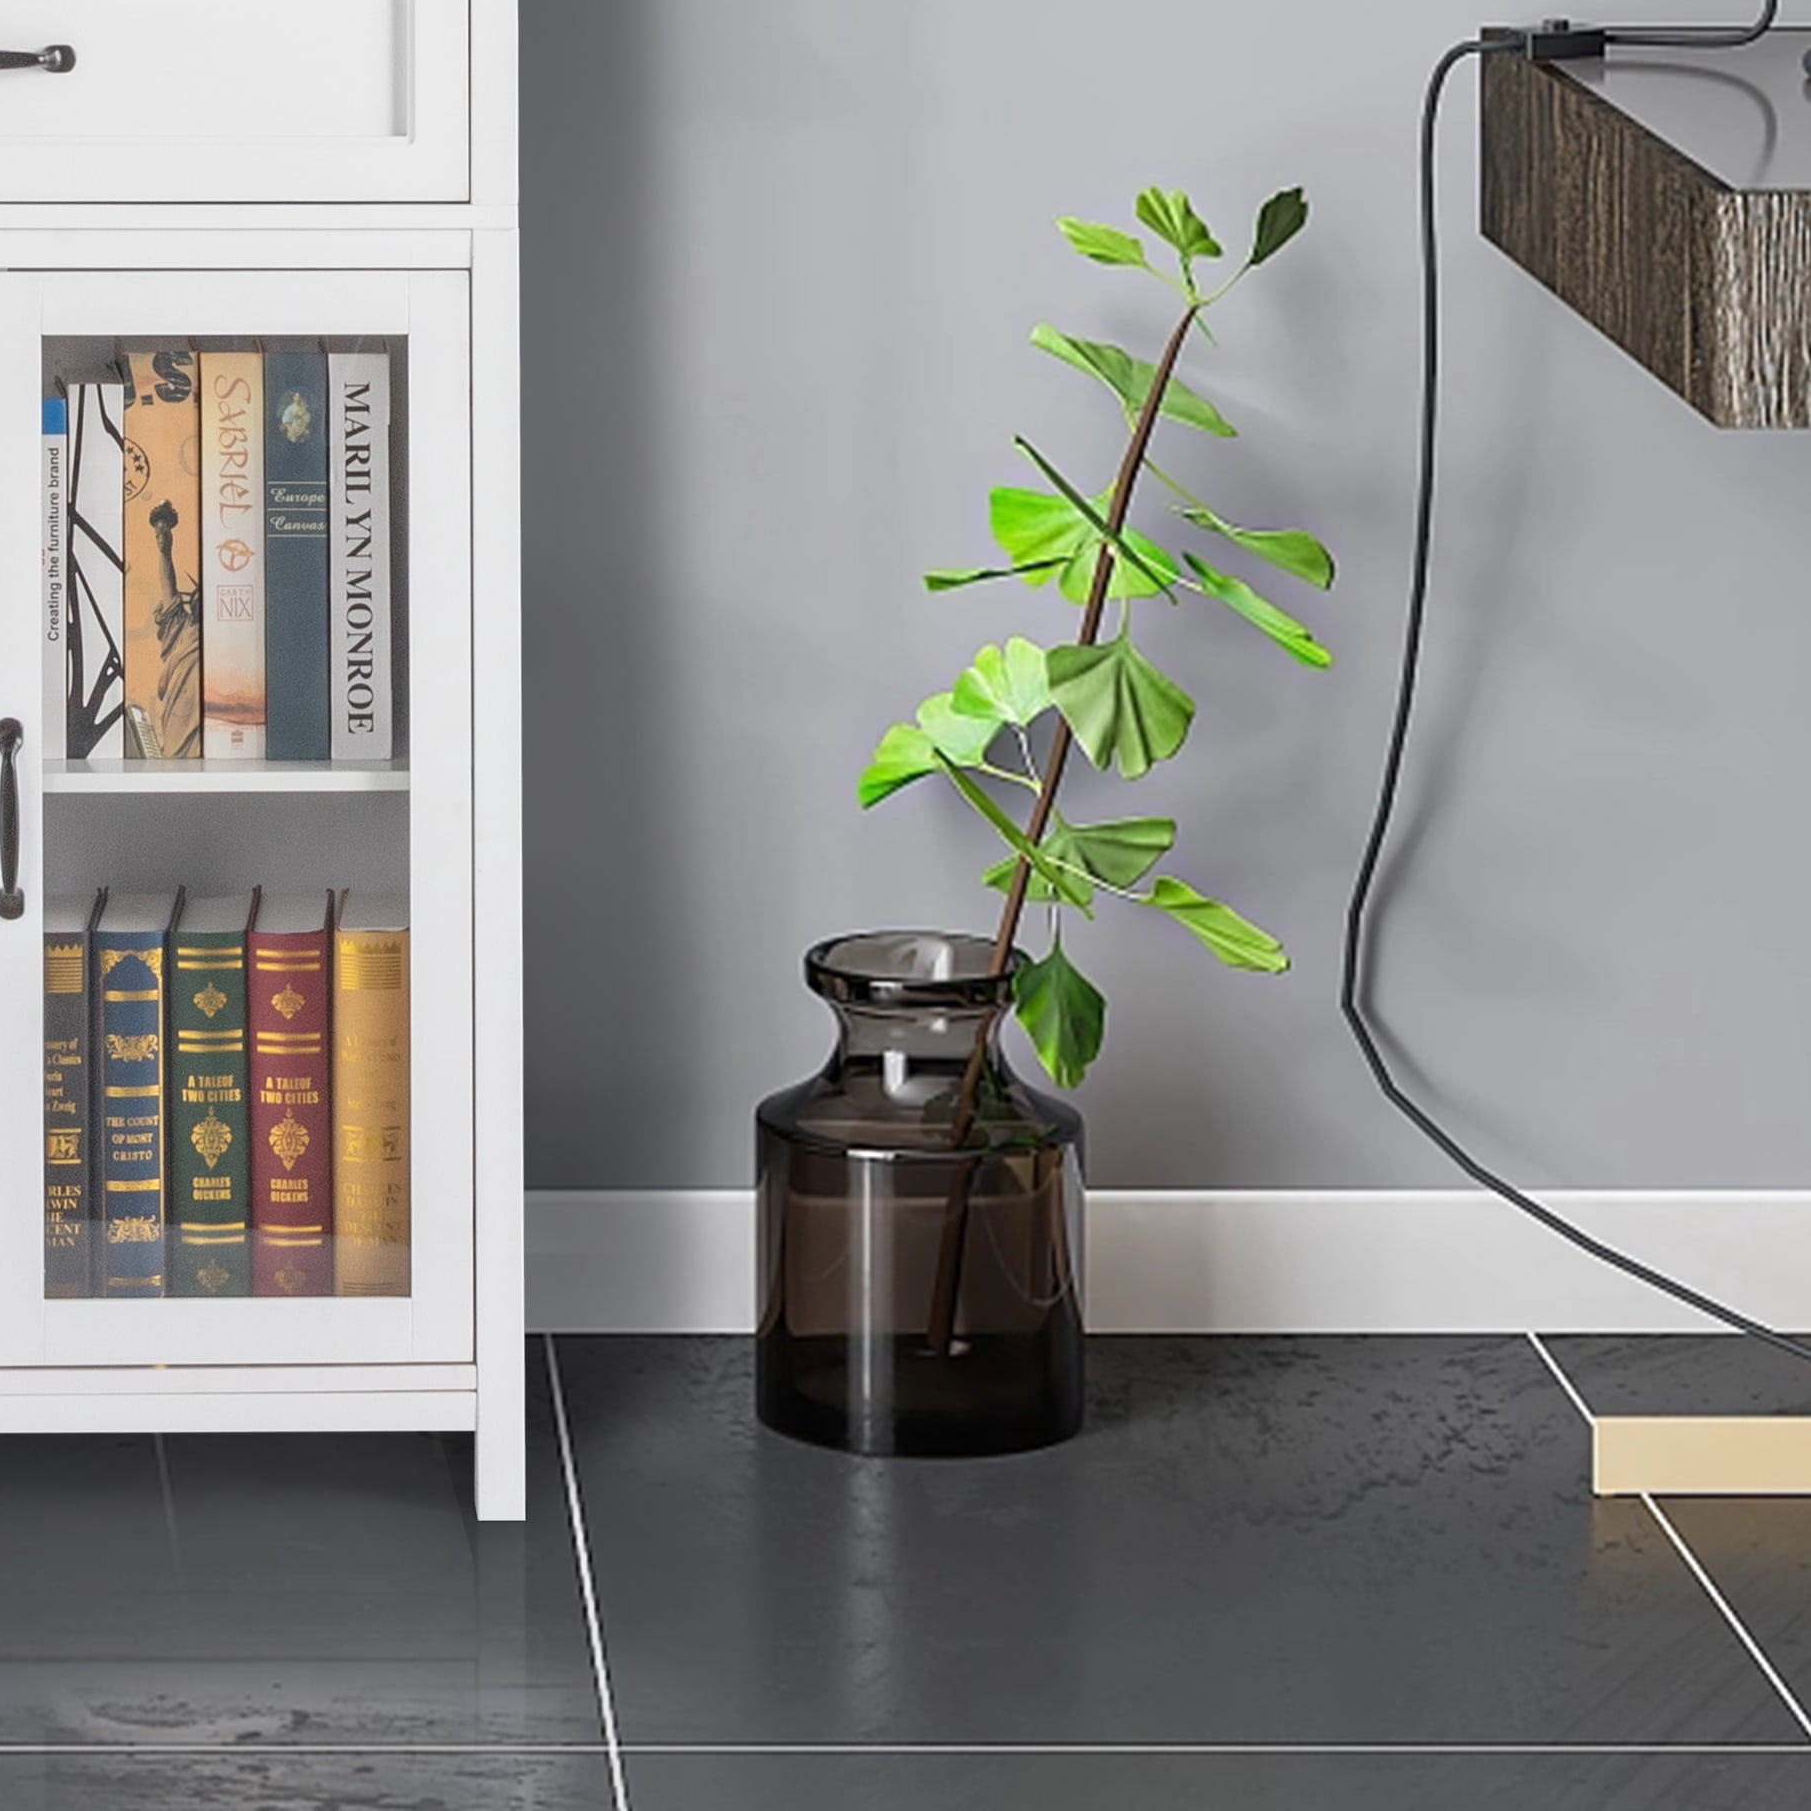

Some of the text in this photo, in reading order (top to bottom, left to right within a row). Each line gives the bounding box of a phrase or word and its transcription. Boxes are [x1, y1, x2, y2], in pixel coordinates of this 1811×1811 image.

[214, 374, 253, 529] SABRIEL
[270, 488, 326, 506] Europe
[270, 516, 327, 531] Canvas
[47, 447, 62, 642] Creating the furniture brand
[344, 381, 375, 735] MARILYN MONROE
[220, 597, 252, 618] NIX
[188, 1075, 196, 1087] A
[266, 1077, 273, 1088] A
[182, 1089, 241, 1102] TWO CITIES
[260, 1091, 319, 1104] TWO CITIES
[113, 1150, 152, 1161] CRISTO
[193, 1177, 231, 1188] CHARLES
[270, 1179, 308, 1189] CHARLES
[193, 1189, 231, 1201] DICKENS
[270, 1191, 308, 1202] DICKENS
[47, 1198, 77, 1209] WIN
